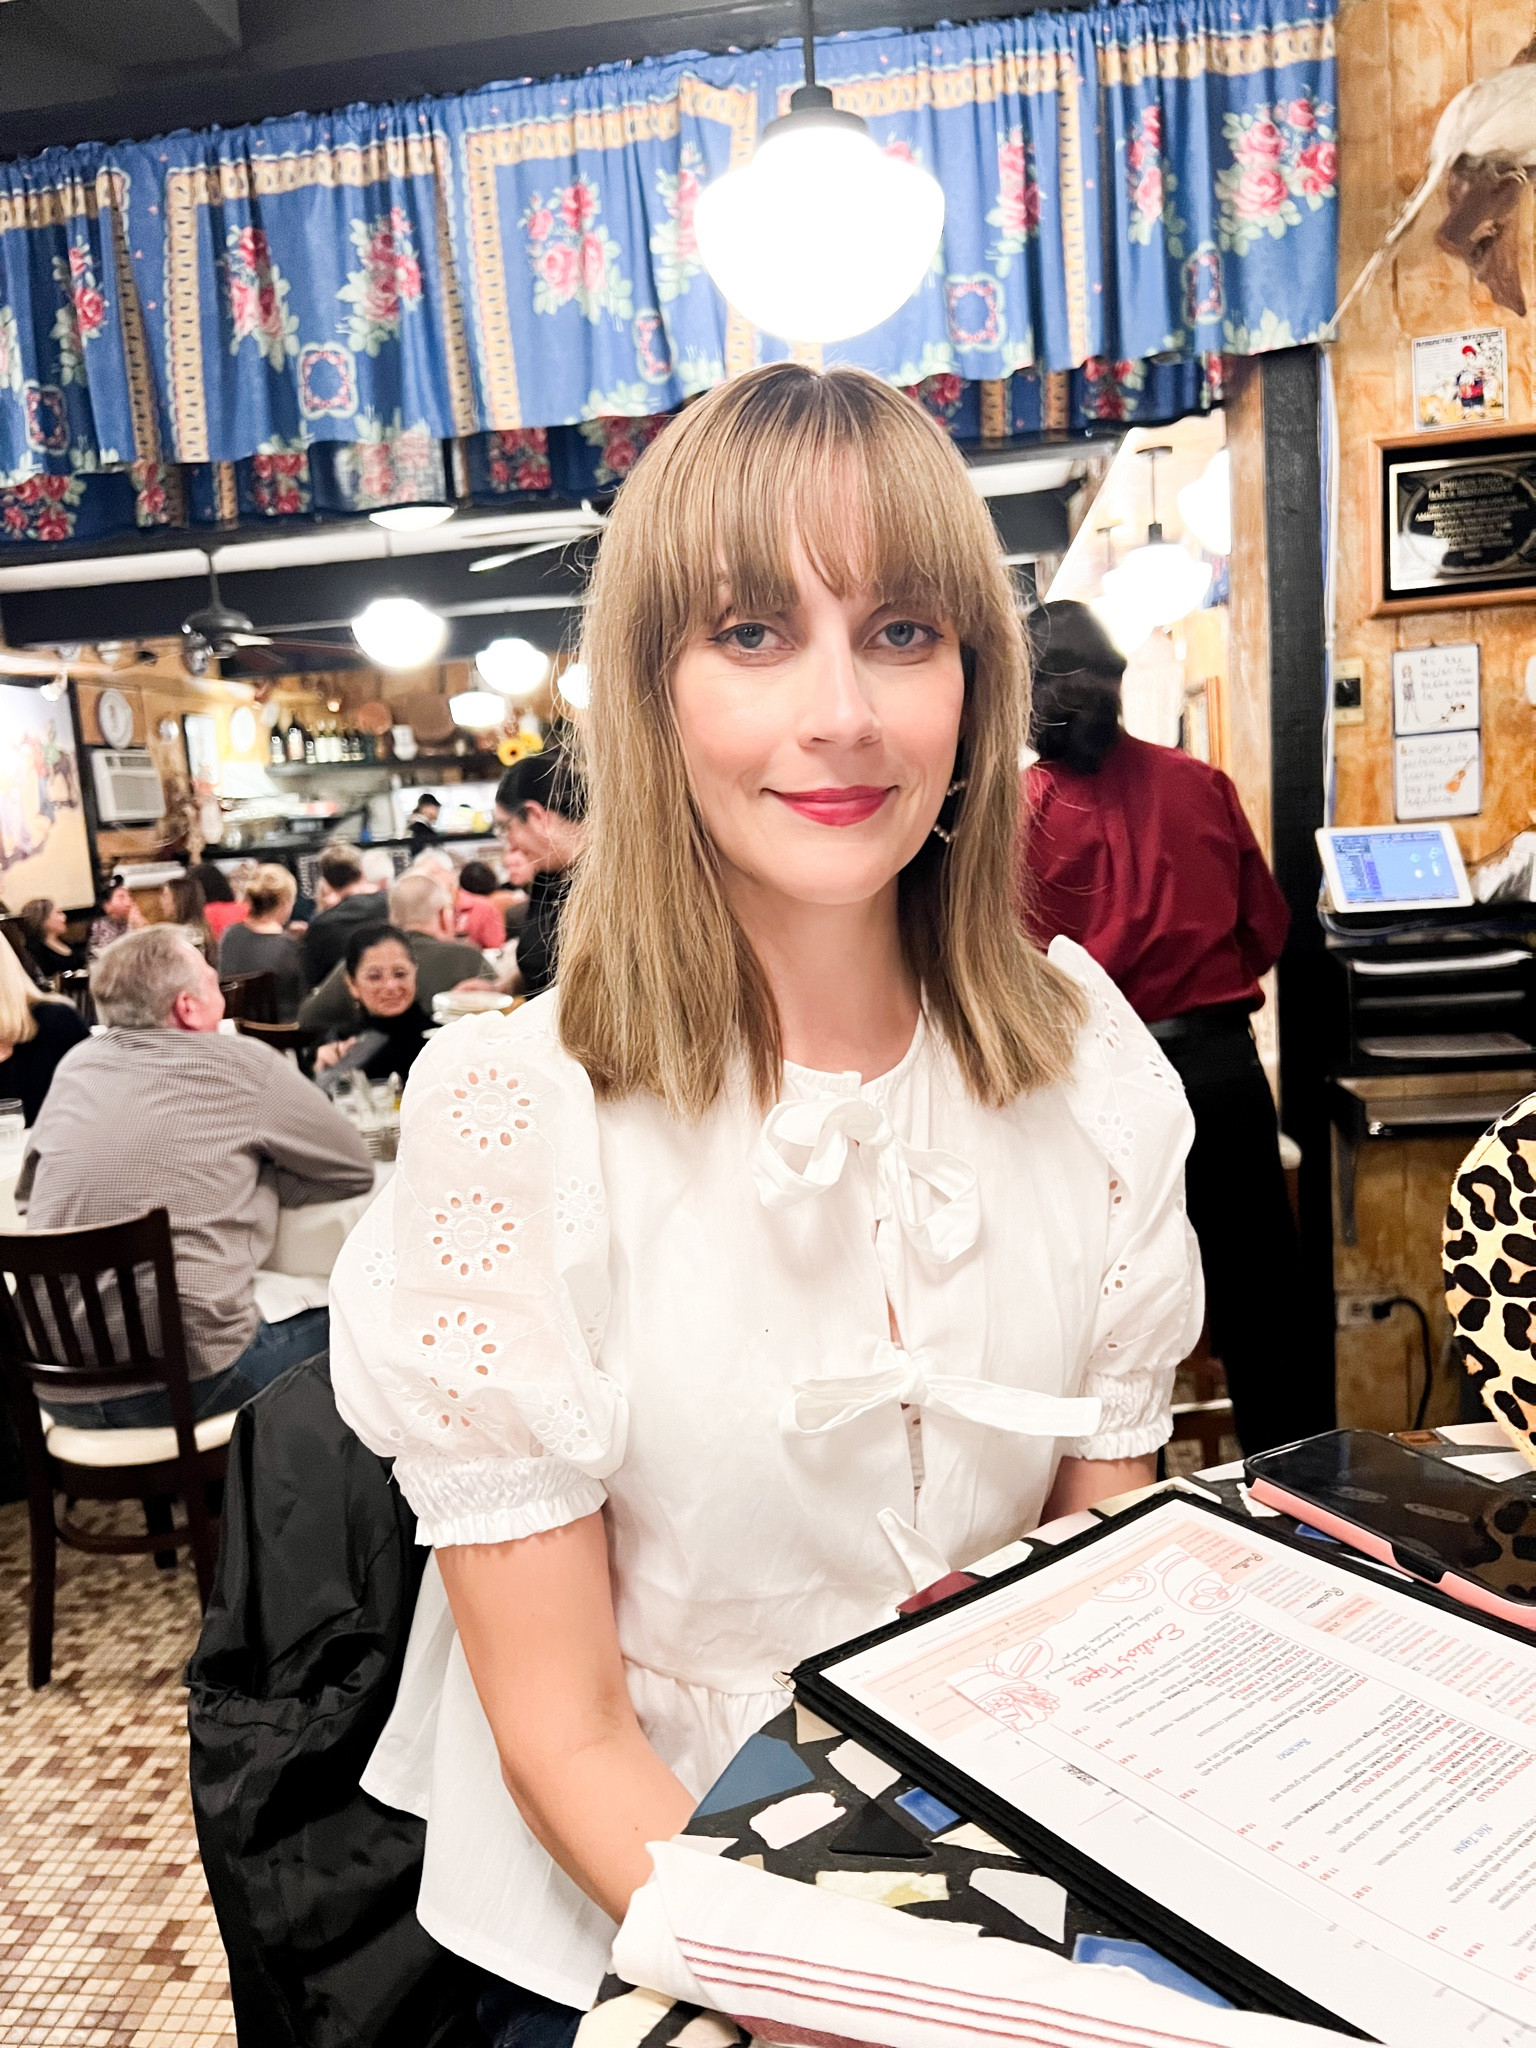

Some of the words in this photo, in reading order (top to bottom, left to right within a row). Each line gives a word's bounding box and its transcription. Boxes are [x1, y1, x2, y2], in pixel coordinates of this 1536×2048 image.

[1118, 1624, 1184, 1663] Emilio's
[1250, 1637, 1282, 1658] SOLOMILLO
[1189, 1650, 1220, 1669] MARISCOS
[1272, 1656, 1296, 1672] ESPADA
[1074, 1664, 1134, 1686] Tapas
[1205, 1666, 1237, 1686] CABRALES
[1346, 1677, 1368, 1692] PEPITO
[1230, 1681, 1259, 1699] PARRILLA
[1271, 1680, 1304, 1702] COUSCOUS
[1314, 1698, 1339, 1714] VENADO
[1382, 1722, 1403, 1736] POLLO
[1423, 1718, 1456, 1740] EMPANADA
[1458, 1732, 1485, 1751] ALMEJAS
[1479, 1741, 1506, 1760] CAZUELA
[1382, 1750, 1411, 1771] CAMPERA
[1429, 1751, 1460, 1772] MARINERA
[1447, 1760, 1480, 1784] ASTURIANA
[1352, 1777, 1374, 1793] POLLO
[1477, 1786, 1498, 1802] POLLO
[1352, 1886, 1372, 1899] 10.95
